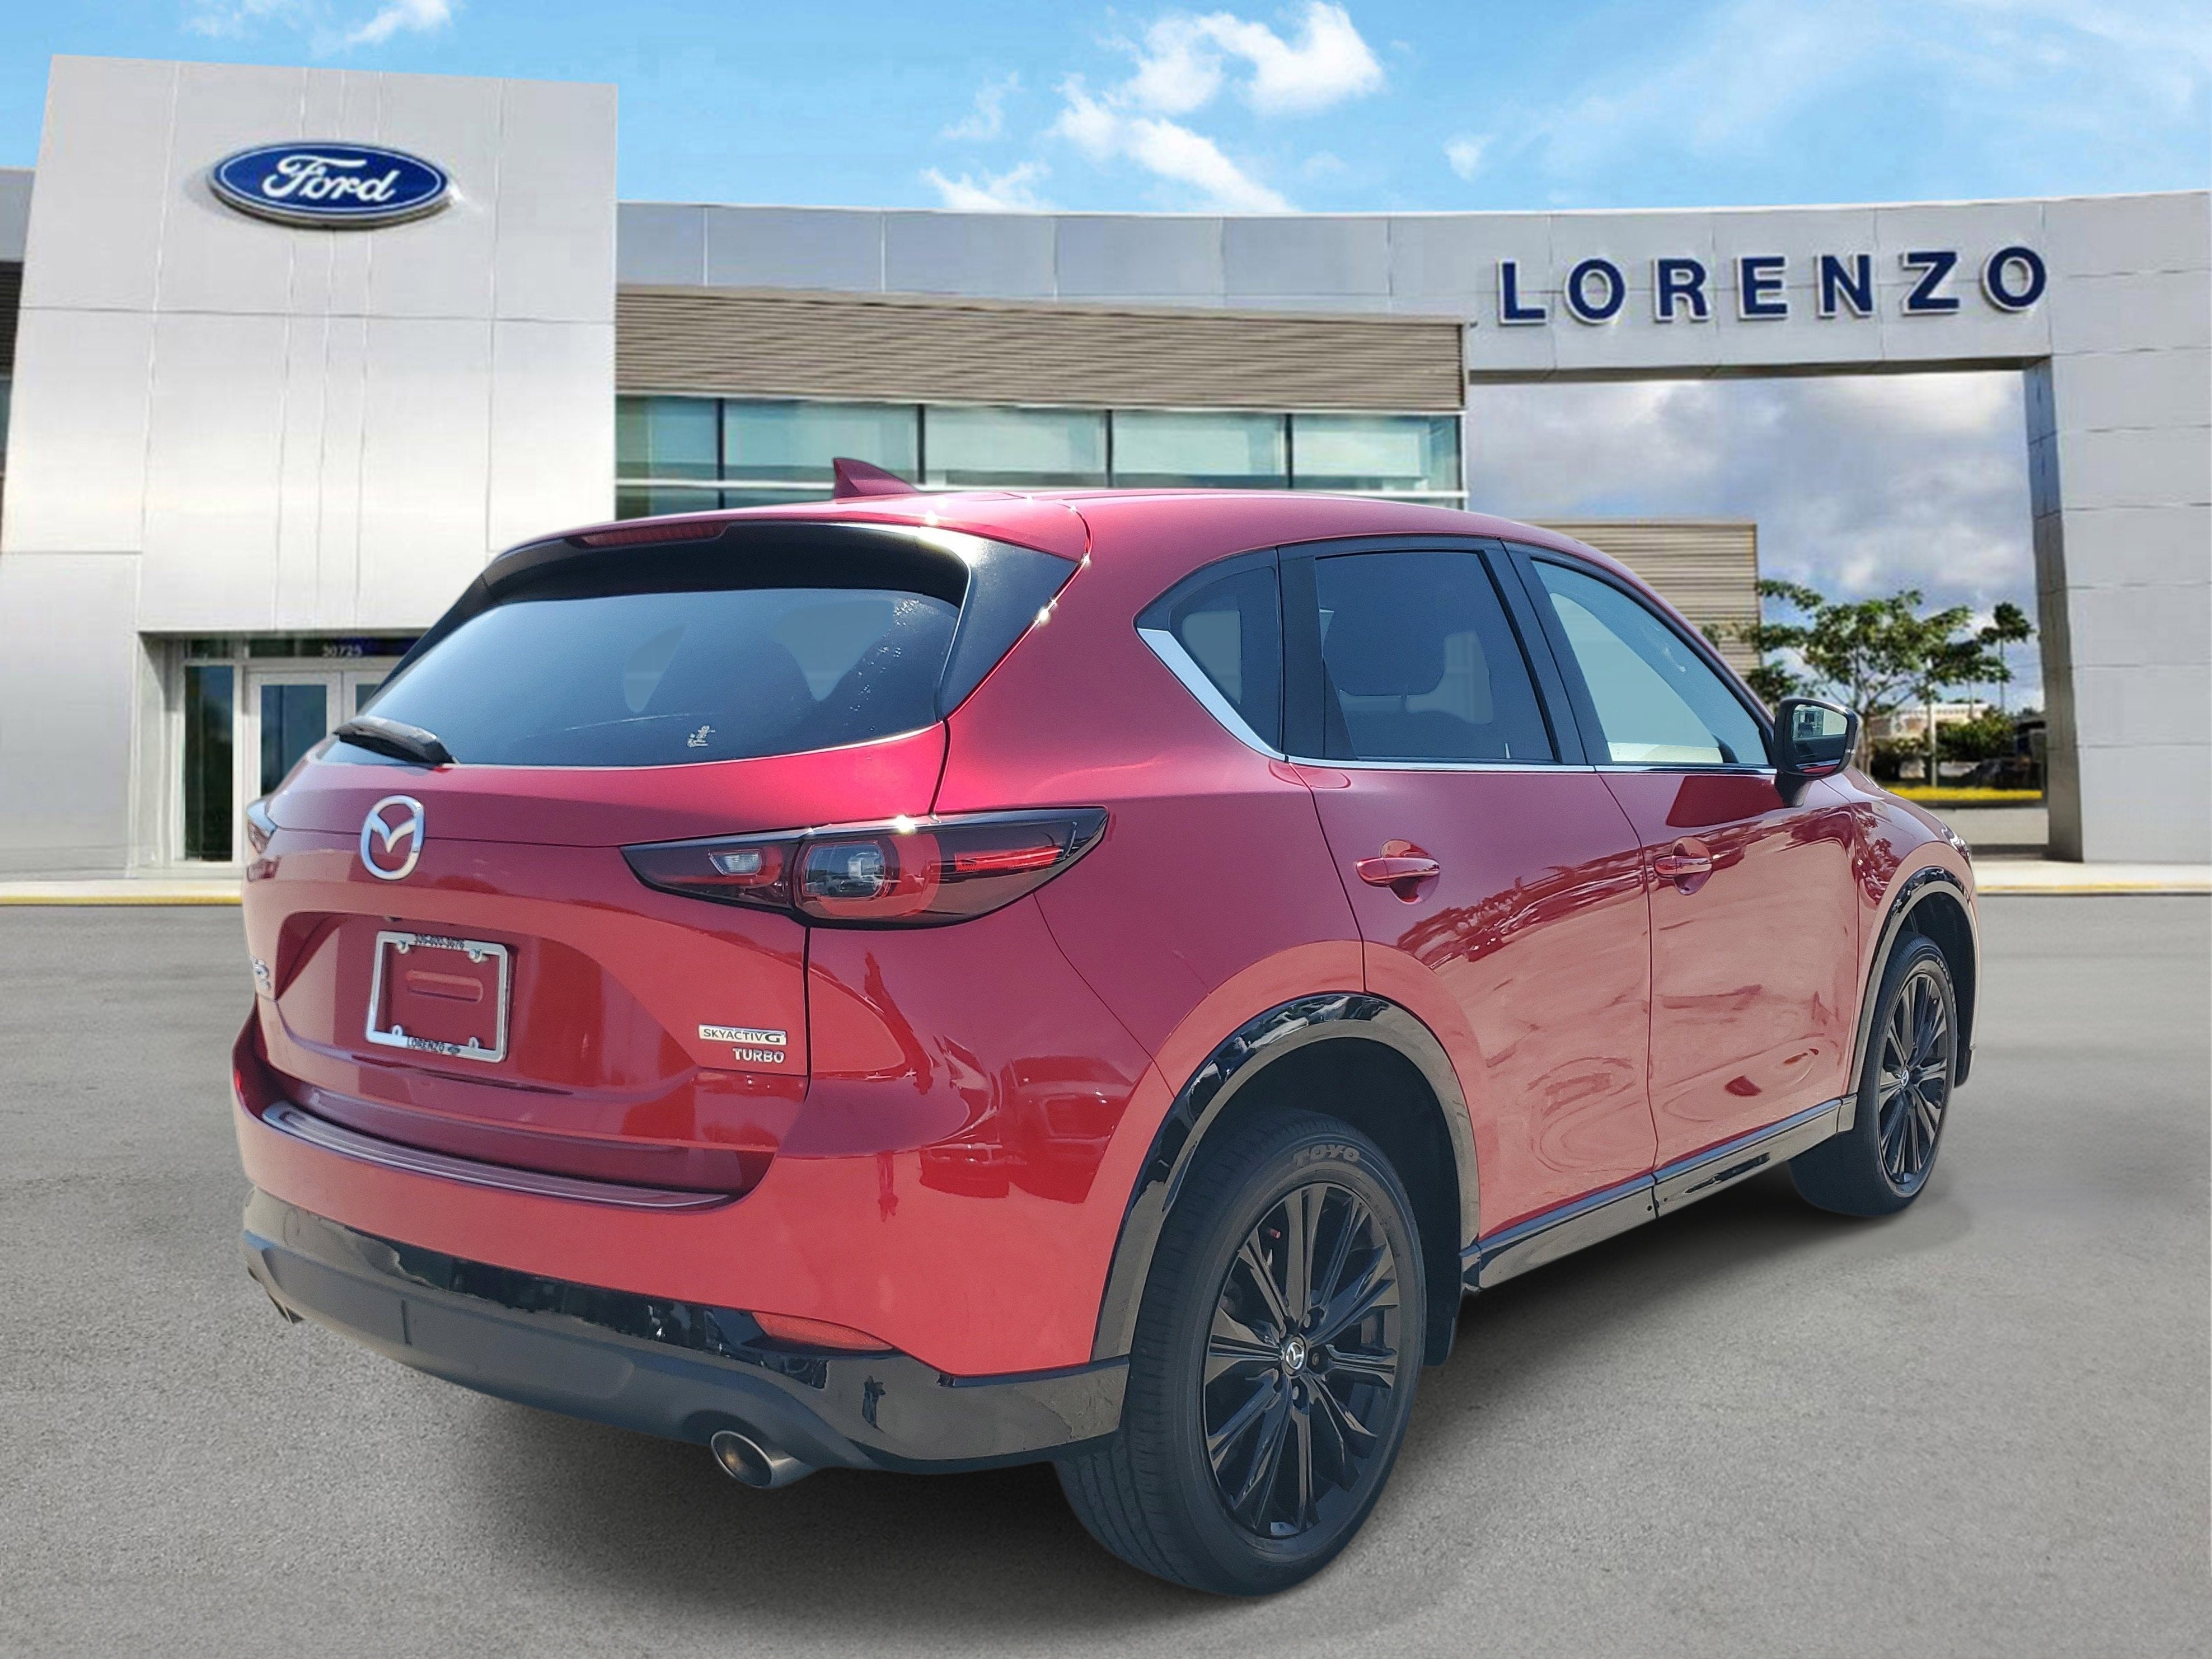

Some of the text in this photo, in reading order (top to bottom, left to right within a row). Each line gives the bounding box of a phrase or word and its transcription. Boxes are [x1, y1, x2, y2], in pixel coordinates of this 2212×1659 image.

[261, 154, 400, 201] Ford
[1497, 246, 2047, 325] LORENZO
[732, 1047, 785, 1063] TURBO
[1293, 1144, 1360, 1169] TOYO
